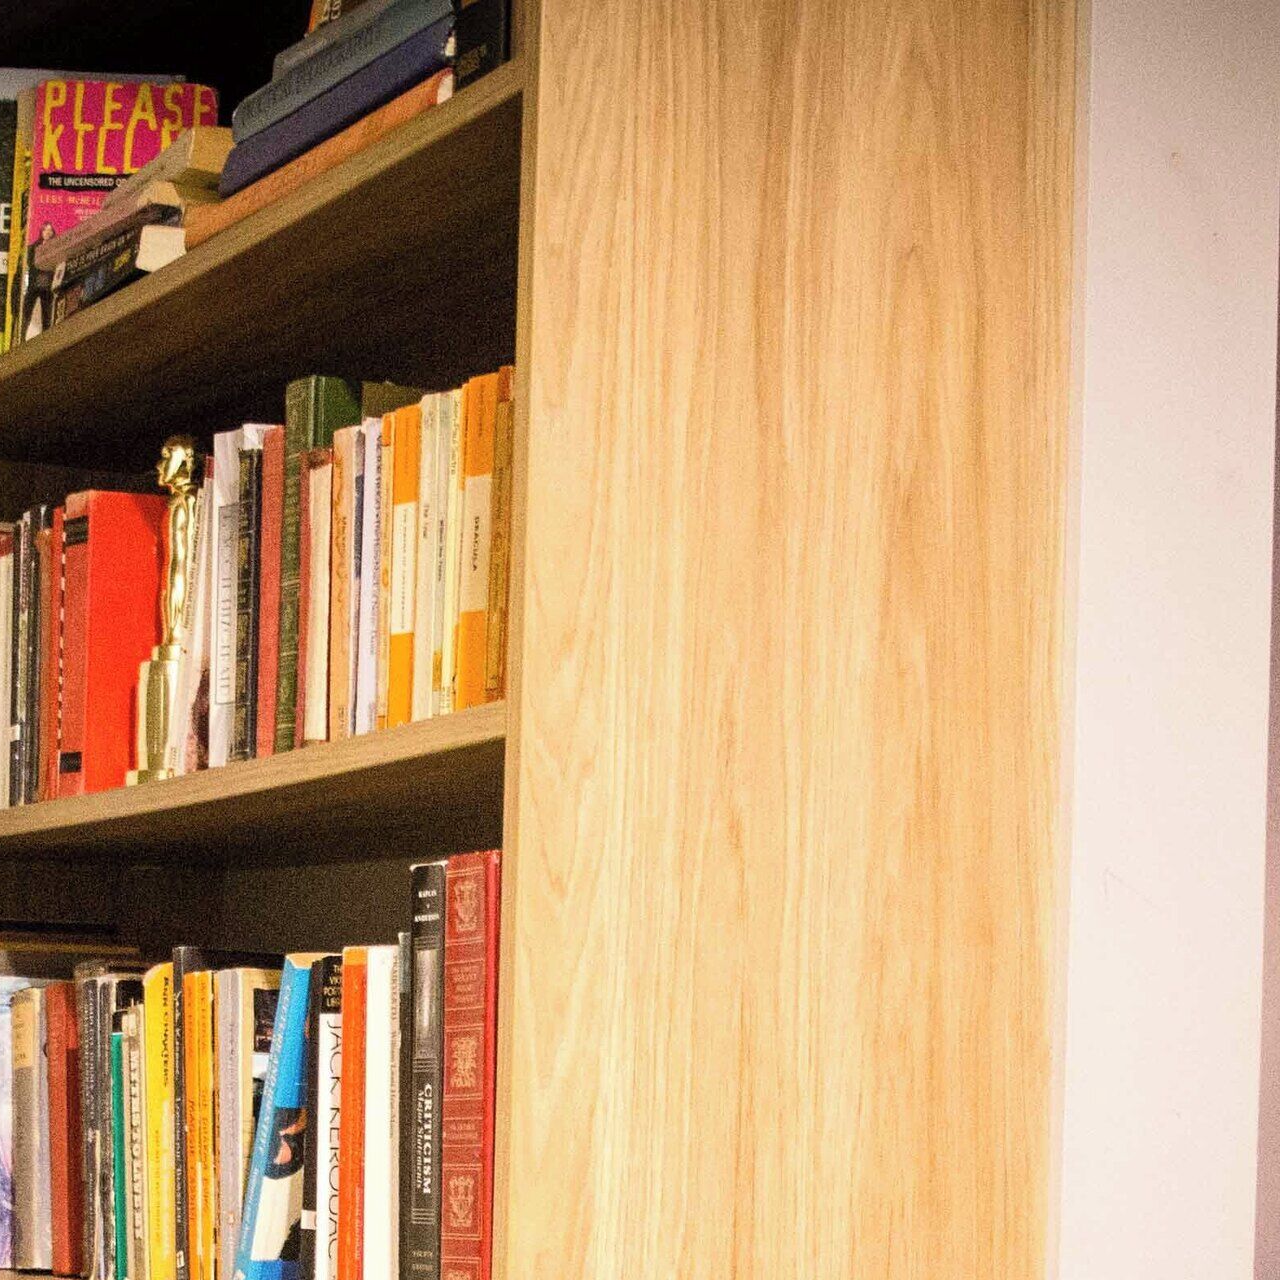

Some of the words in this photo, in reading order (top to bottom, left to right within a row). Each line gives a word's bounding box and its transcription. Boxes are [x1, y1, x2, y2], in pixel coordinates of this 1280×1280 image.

[45, 80, 211, 131] PLEASE
[42, 124, 140, 174] KILL
[48, 177, 62, 186] THE
[64, 177, 114, 187] UNCENSORED
[471, 515, 479, 571] DRACULA
[326, 1019, 341, 1096] JACK
[415, 1089, 423, 1122] Major
[130, 1127, 141, 1156] TO
[415, 1126, 423, 1188] Statements
[422, 1082, 432, 1193] CRITICISM
[327, 1107, 340, 1260] KEROUAC
